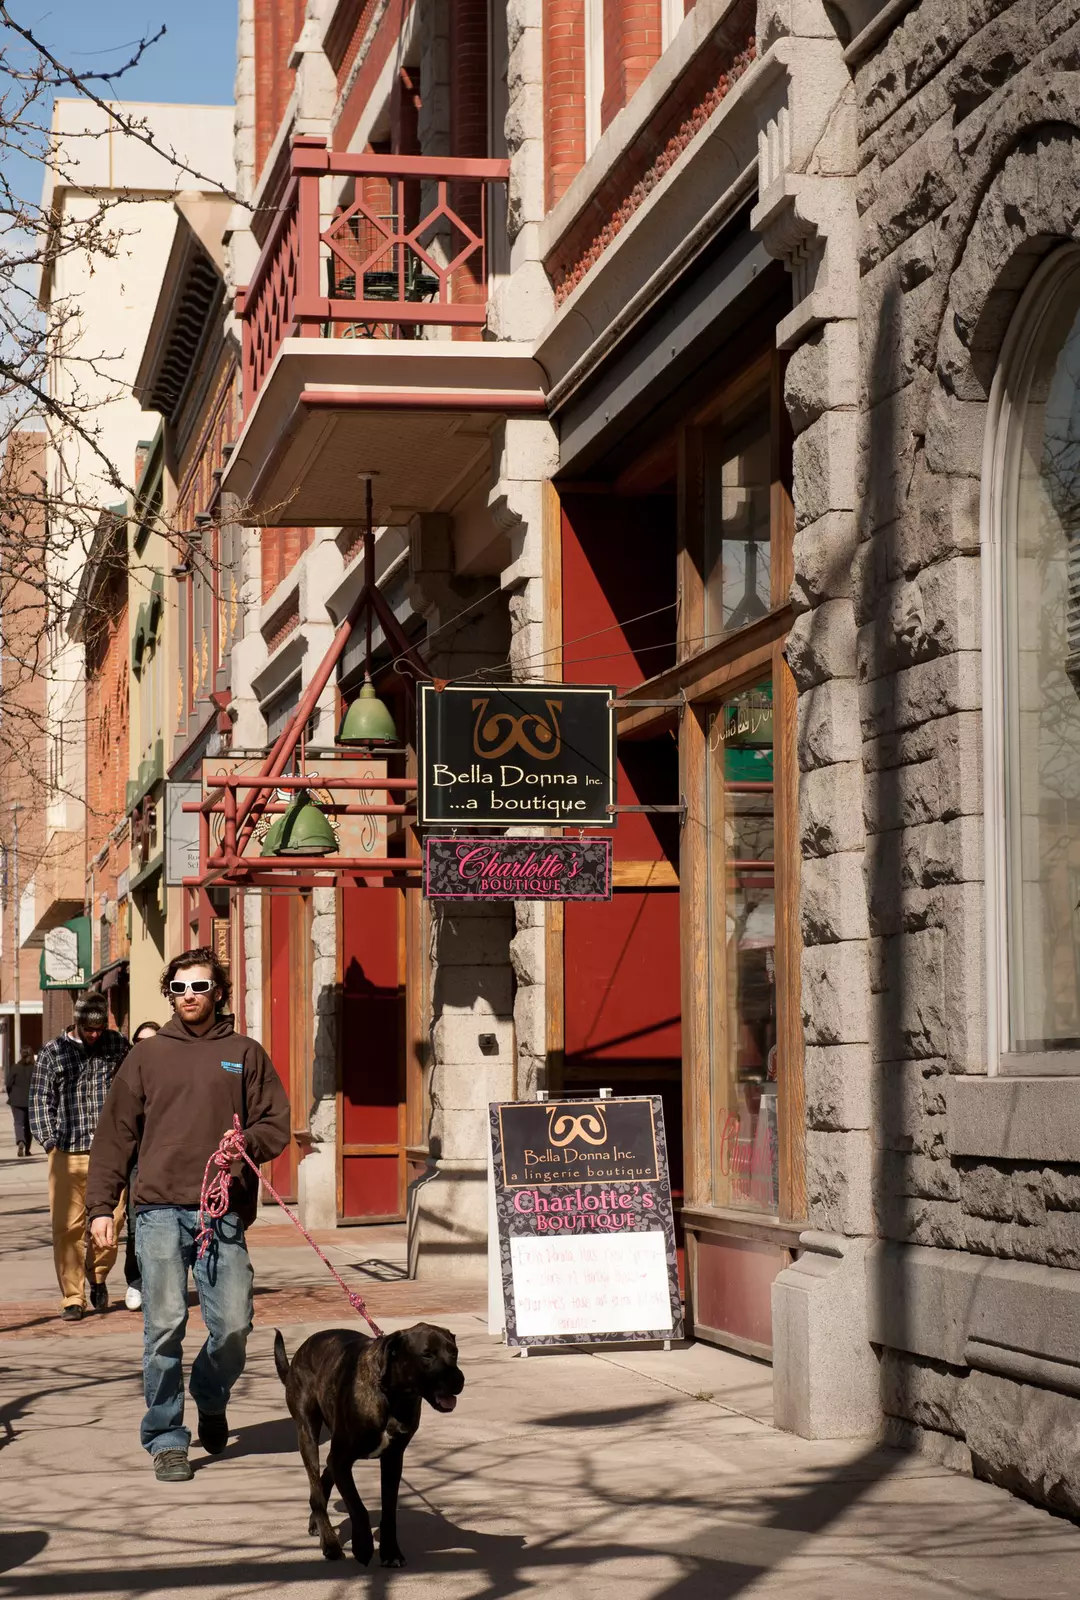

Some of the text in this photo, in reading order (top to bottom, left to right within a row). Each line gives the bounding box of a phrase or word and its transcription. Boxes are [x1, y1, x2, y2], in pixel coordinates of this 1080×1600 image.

[433, 764, 603, 787] Bella Donna Inc.
[450, 790, 587, 818] ...a boutique
[456, 844, 584, 879] Charlotte's
[481, 879, 562, 893] BOUTIQUE
[218, 929, 227, 961] BOOKS
[523, 1146, 636, 1166] Bella Donna Inc.
[511, 1165, 652, 1183] a lingerie boutique
[513, 1186, 654, 1214] Charlotte's
[536, 1212, 636, 1231] BOUTIQUE
